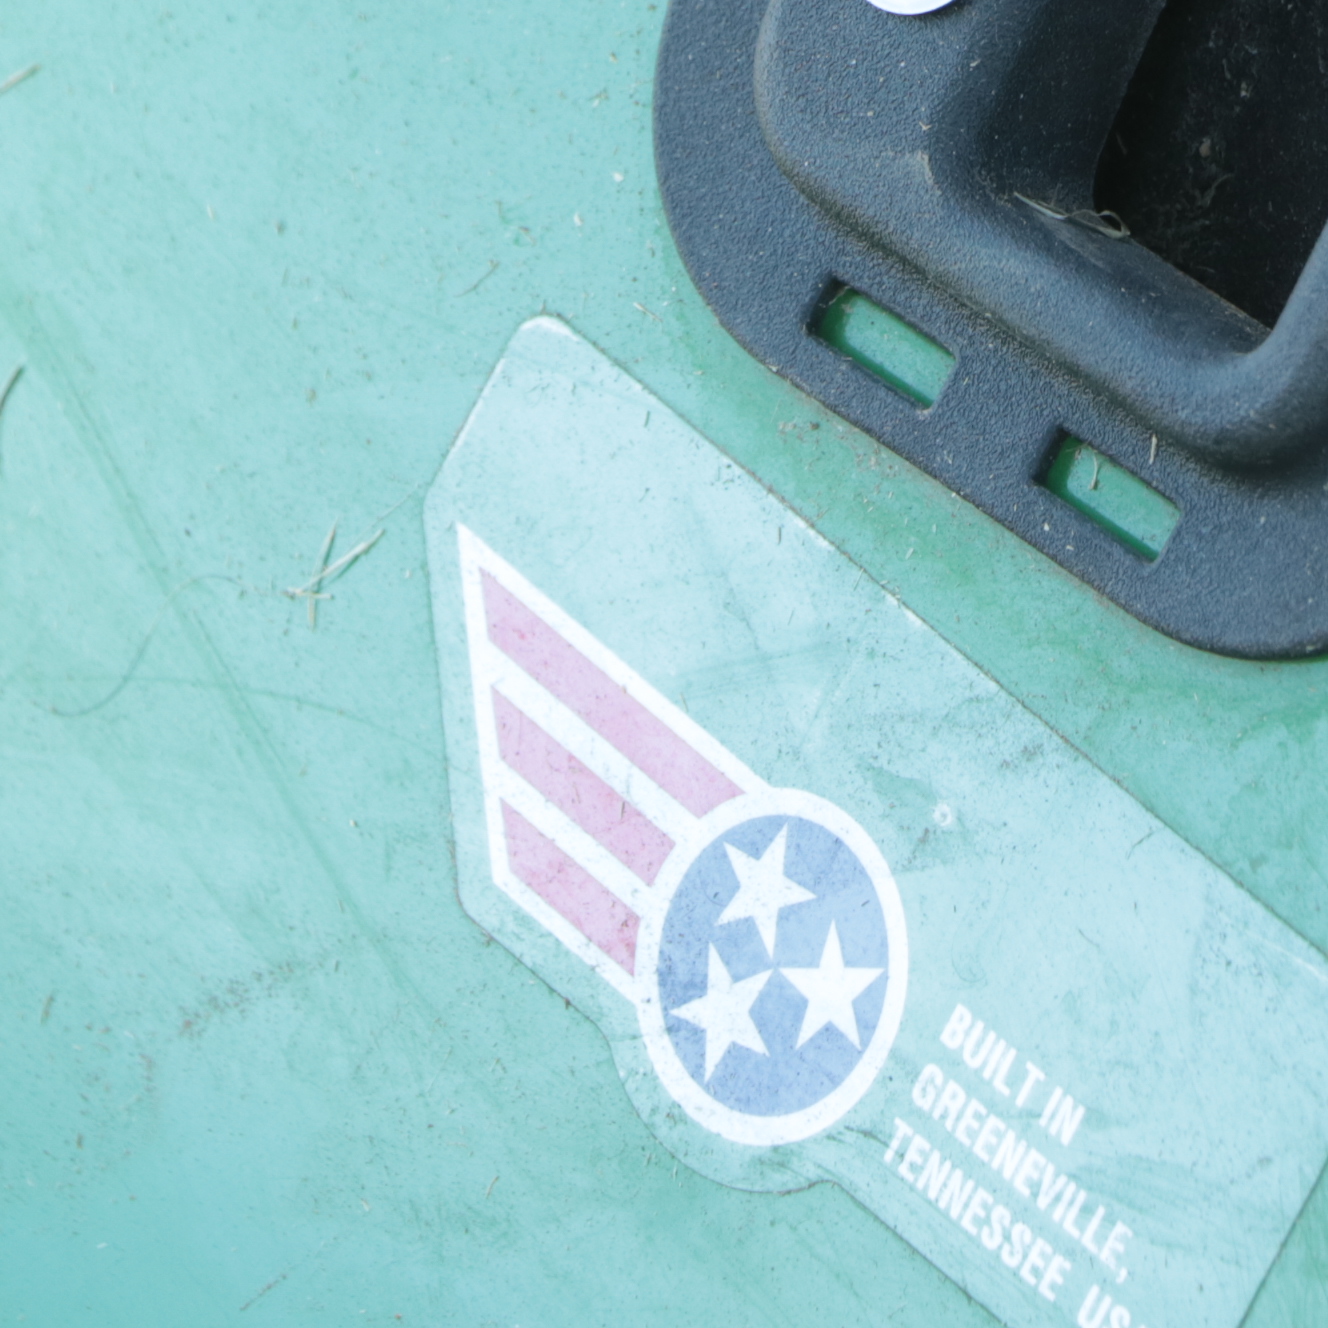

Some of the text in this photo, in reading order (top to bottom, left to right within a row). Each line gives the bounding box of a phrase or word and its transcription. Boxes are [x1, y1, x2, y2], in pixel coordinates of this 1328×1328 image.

[939, 1003, 1085, 1147] BUILT IN
[883, 1116, 1072, 1302] TENNESSEE
[911, 1062, 1134, 1284] GREENEVILLE,
